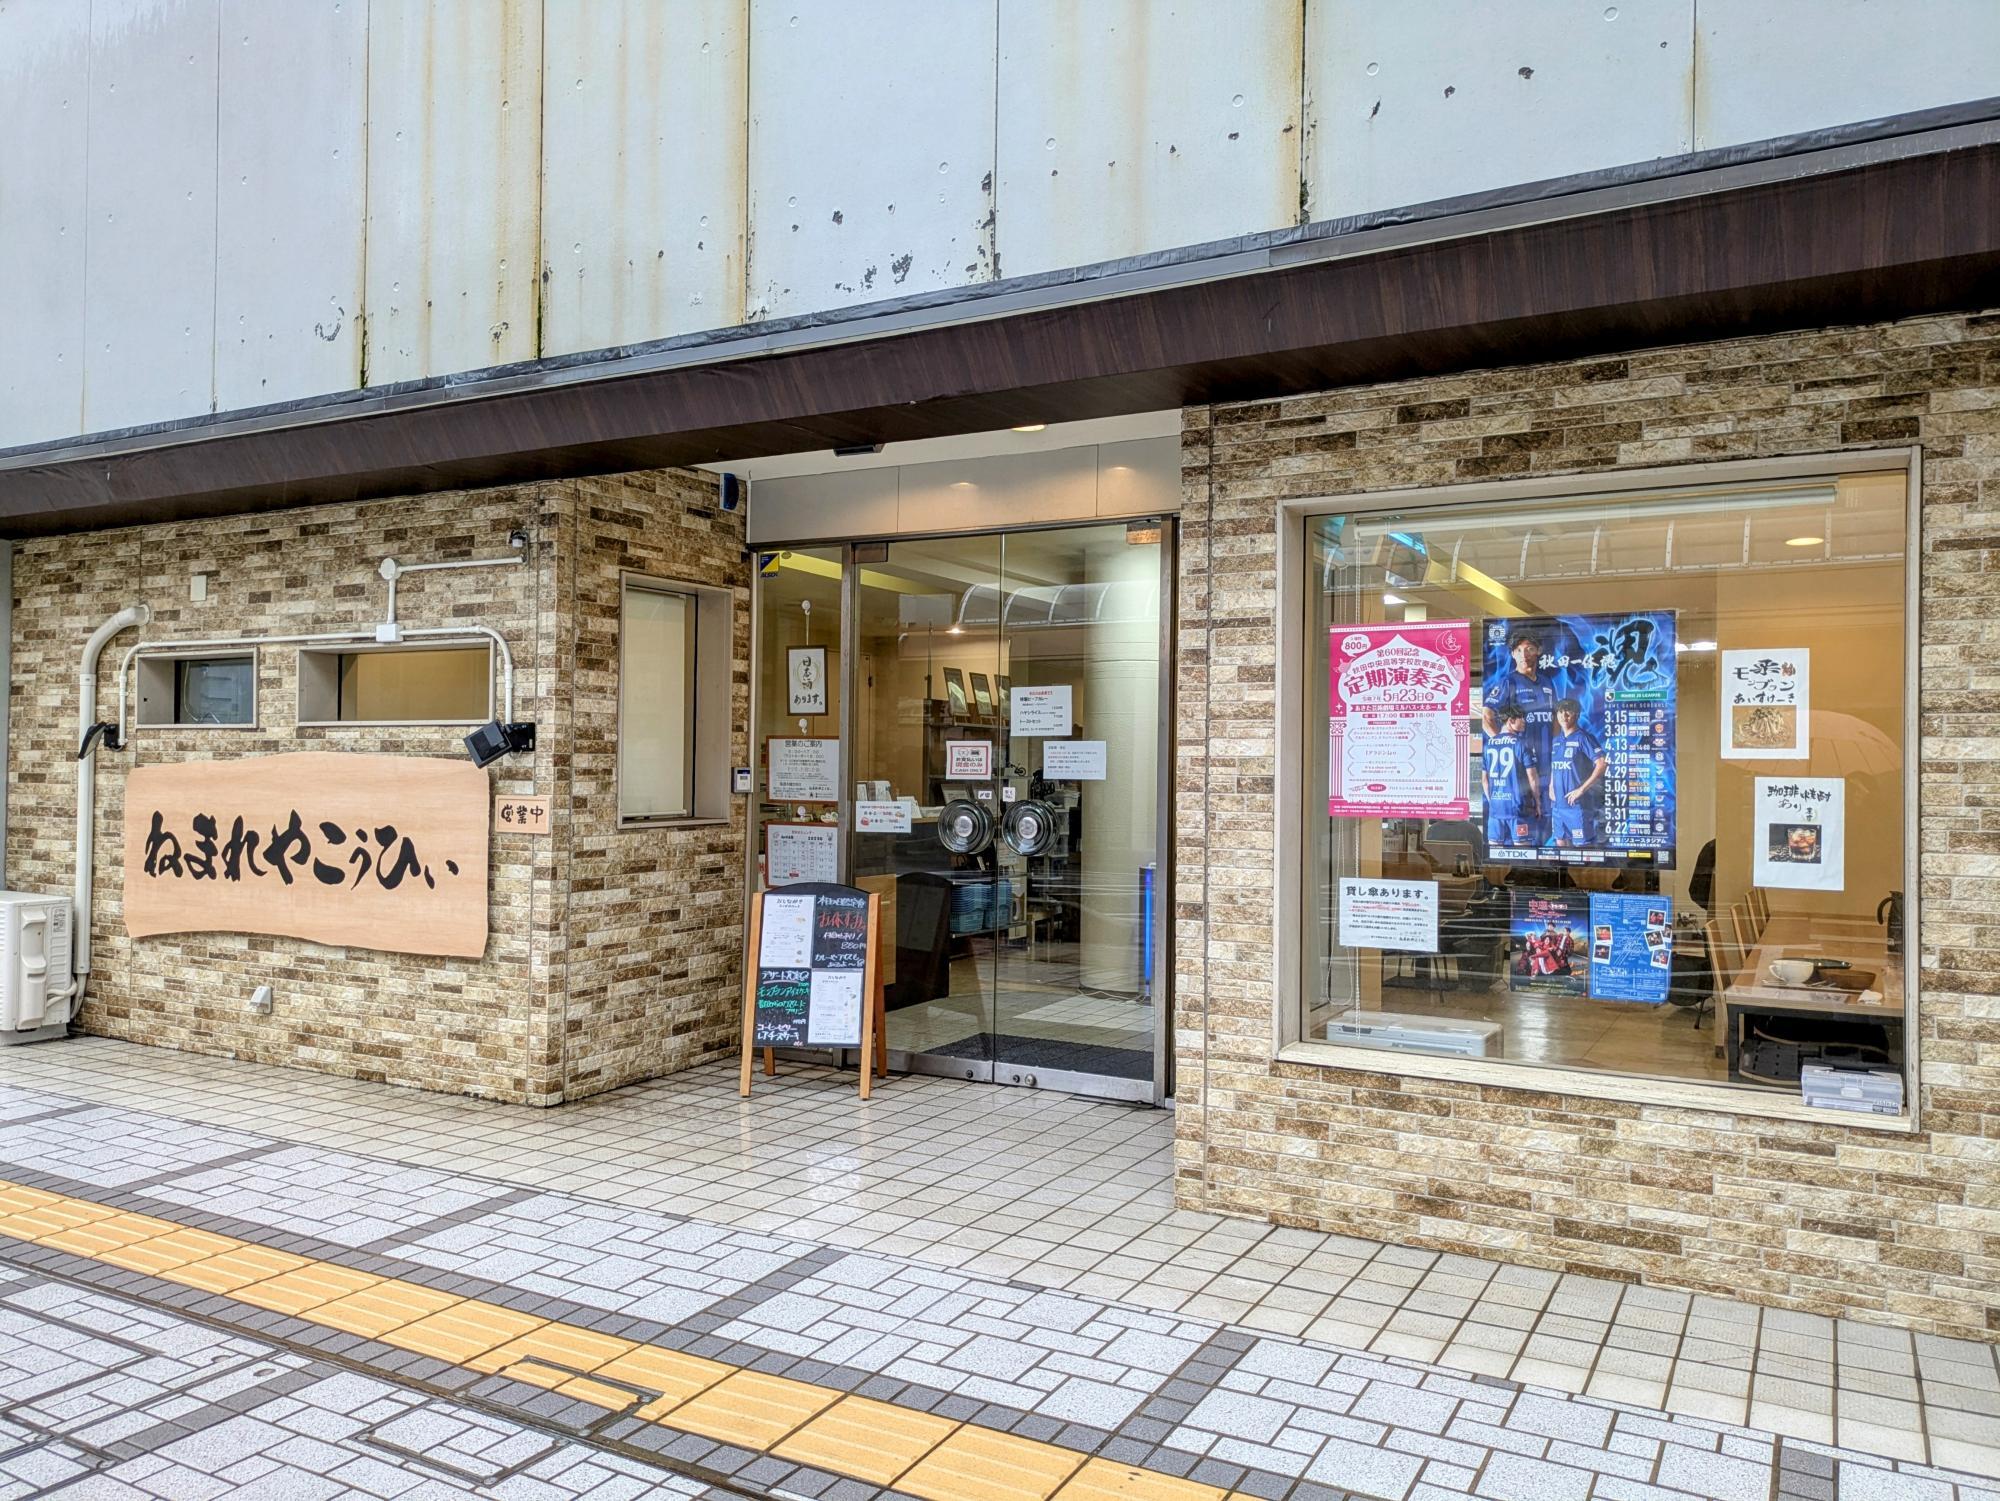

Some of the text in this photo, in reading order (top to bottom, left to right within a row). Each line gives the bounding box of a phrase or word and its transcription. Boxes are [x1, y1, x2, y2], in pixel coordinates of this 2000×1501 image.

[1345, 642, 1367, 650] 800円
[1376, 648, 1419, 657] 第60回記念
[1353, 658, 1446, 675] 秋田中央高等学校吹奏楽部
[1343, 666, 1454, 698] 定期演奏会
[1604, 710, 1627, 723] 3.15
[1604, 724, 1627, 737] 3.30
[785, 740, 822, 748] 営業のご案内
[1604, 738, 1627, 751] 4.13
[1487, 746, 1514, 778] 29
[1604, 752, 1627, 765] 4.20
[1553, 761, 1572, 770] TDK
[1604, 766, 1627, 779] 4.29
[1604, 780, 1627, 792] 5.06
[1604, 794, 1627, 806] 5.17
[500, 803, 544, 825] 営業中
[1604, 808, 1627, 820] 5.31
[1604, 821, 1627, 834] 6.22
[1346, 886, 1429, 900] 貸し傘あります。
